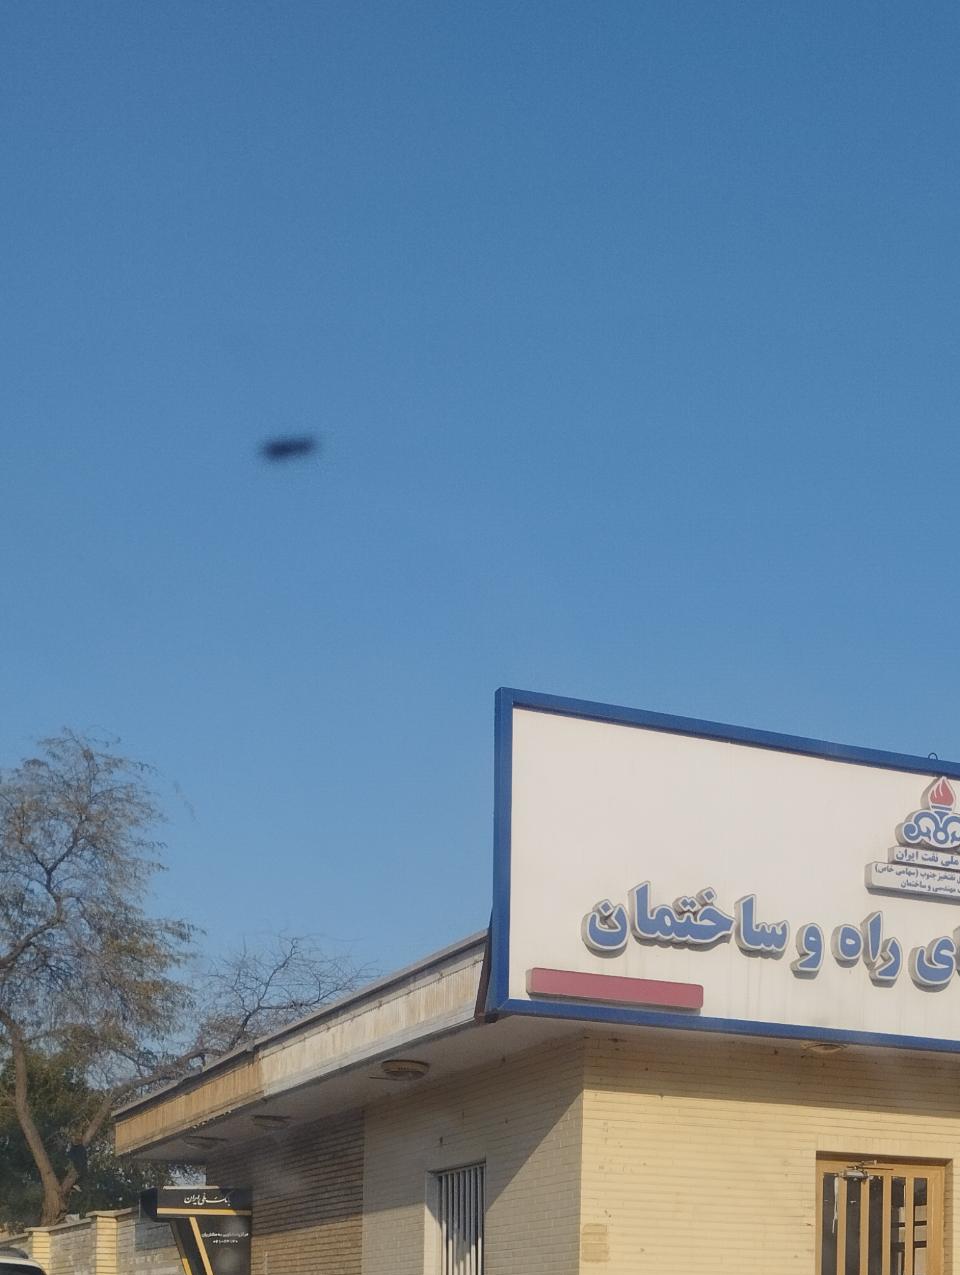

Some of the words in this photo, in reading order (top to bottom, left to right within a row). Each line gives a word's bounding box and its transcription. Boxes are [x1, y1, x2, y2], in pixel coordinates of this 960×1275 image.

[895, 849, 919, 863] ایران
[921, 852, 939, 863] نفت
[941, 854, 959, 867] ملی
[920, 870, 937, 881] جنوب
[900, 880, 927, 890] ساختمان
[932, 884, 957, 894] مهندسی
[583, 880, 790, 957] ساختمان
[795, 921, 825, 977] و
[834, 910, 906, 984] راه
